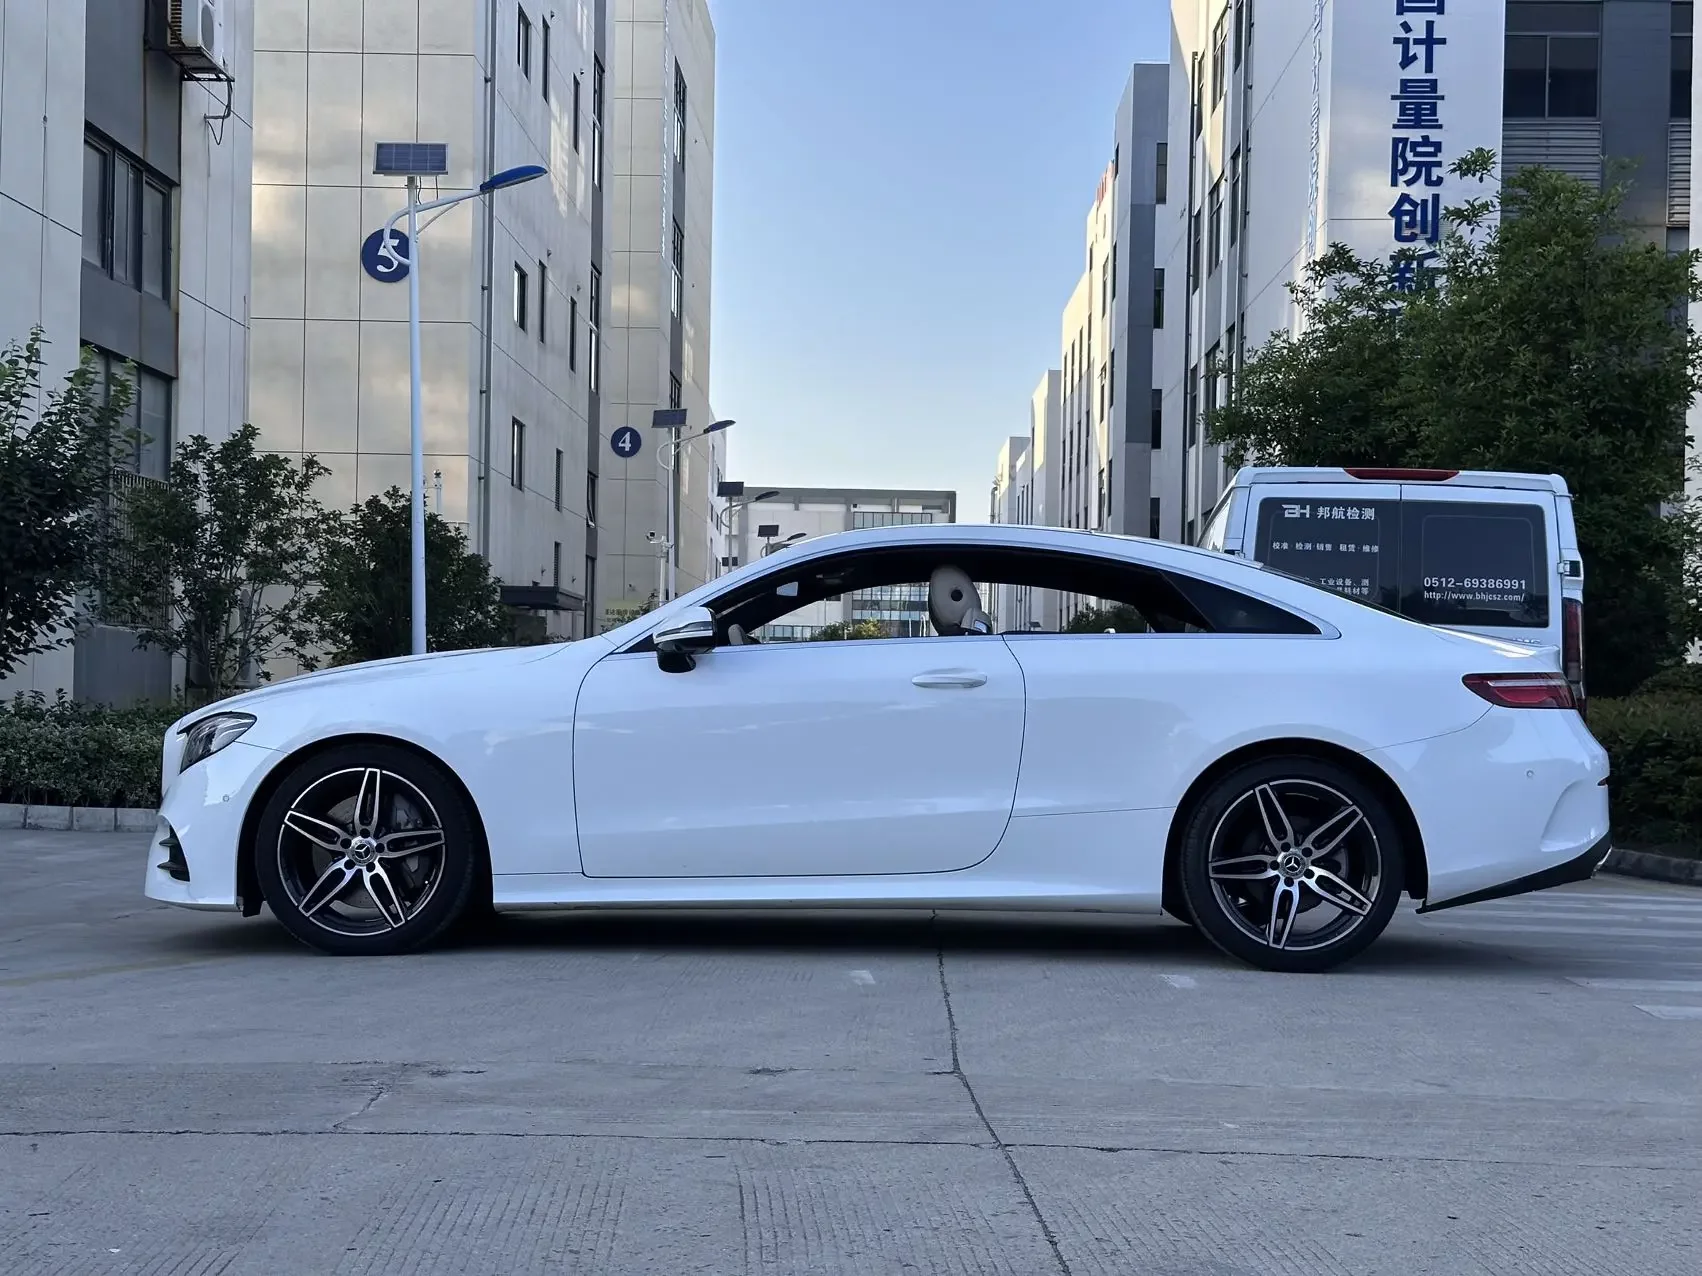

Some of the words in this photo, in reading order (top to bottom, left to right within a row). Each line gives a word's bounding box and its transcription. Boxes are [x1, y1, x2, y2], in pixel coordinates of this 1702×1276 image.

[1388, 0, 1447, 292] 计量院创新
[376, 238, 400, 273] 5
[618, 431, 632, 452] 4
[1317, 506, 1375, 520] 邦航检测
[1424, 577, 1526, 590] 0512-69386991
[1424, 591, 1525, 602] http://www.bhjcsz.com/
